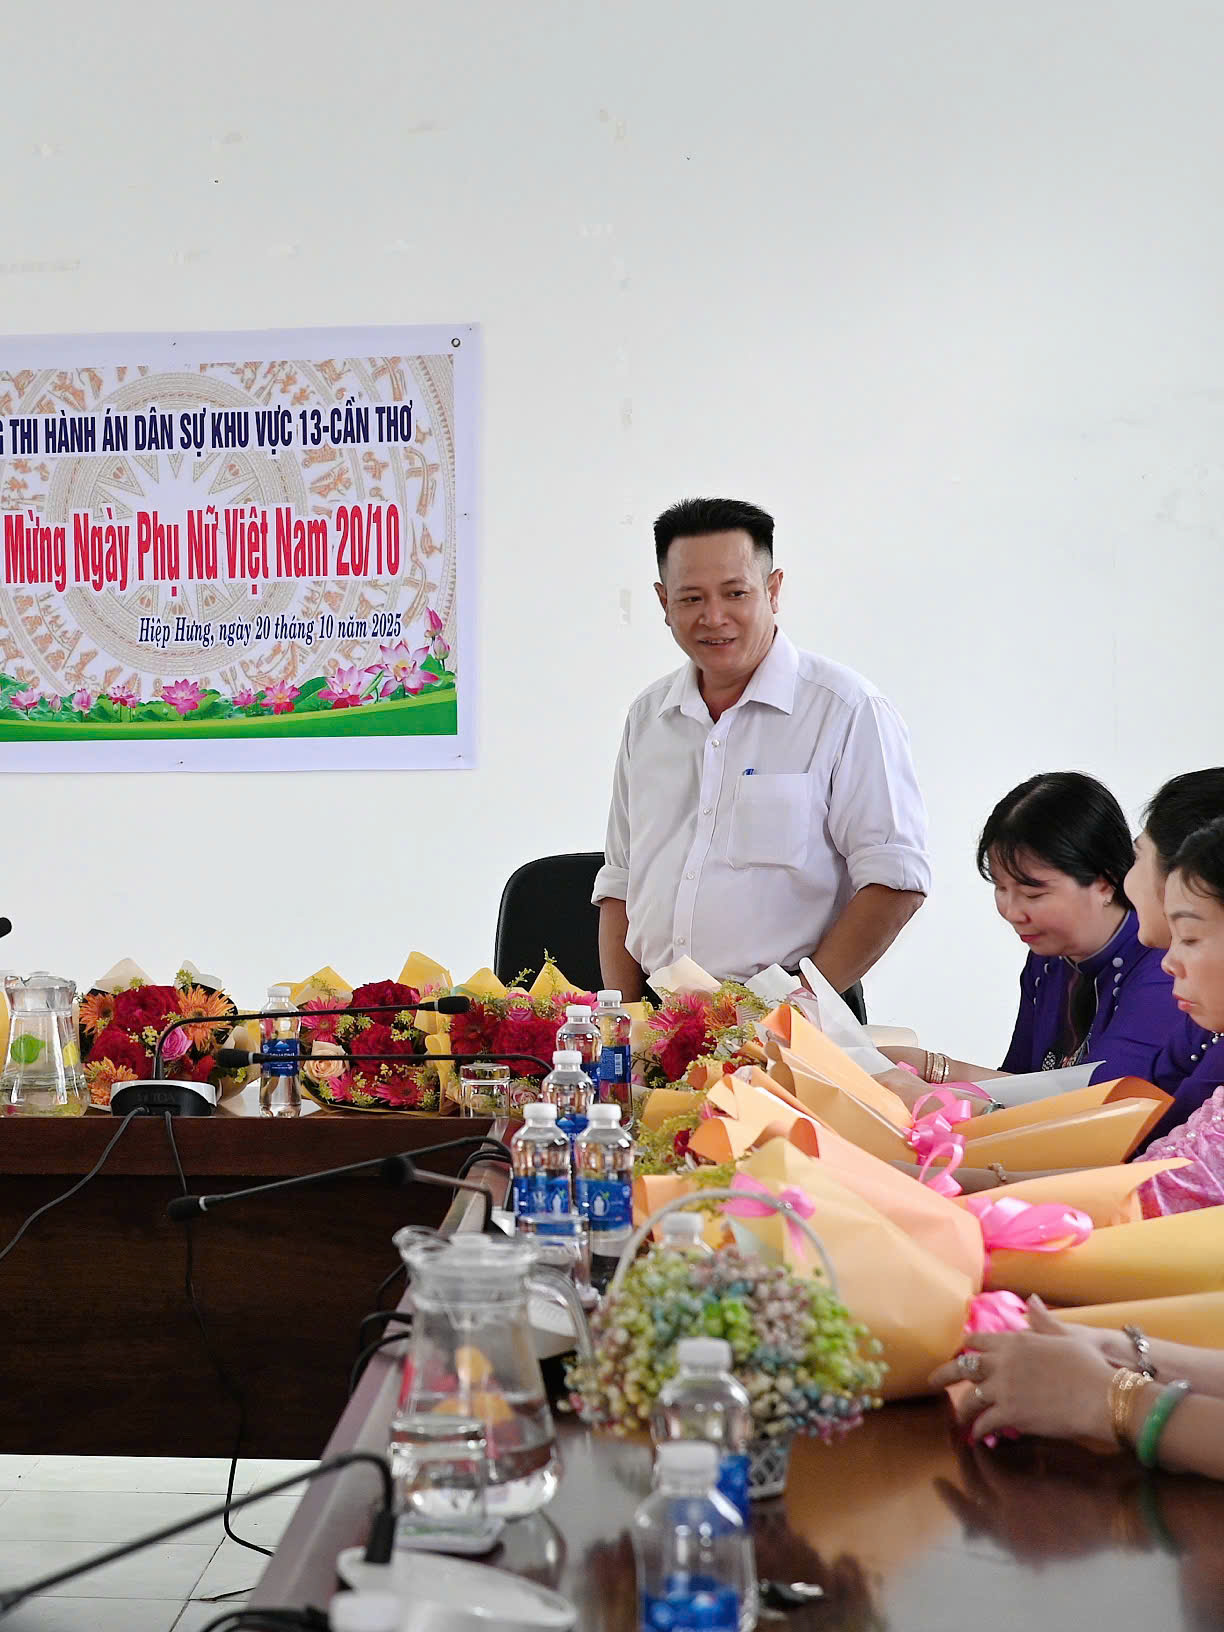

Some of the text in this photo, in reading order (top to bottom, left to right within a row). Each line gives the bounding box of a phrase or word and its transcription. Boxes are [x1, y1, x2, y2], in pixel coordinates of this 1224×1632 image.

[9, 418, 38, 455] THI
[45, 409, 96, 454] HÀNH
[102, 408, 128, 452] ÁN
[134, 406, 174, 451] DÂN
[179, 407, 207, 457] SỰ
[211, 411, 249, 449] KHU
[255, 404, 293, 455] VỰC
[375, 400, 413, 443] THƠ
[4, 509, 67, 592] Mừng
[73, 507, 130, 592] Ngày
[137, 510, 180, 597] Phụ
[187, 505, 219, 580] Nữ
[224, 506, 269, 595] Việt
[275, 507, 328, 578] Nam
[336, 503, 400, 576] 20/10
[139, 613, 402, 648] Hiệp Hưng, ngày 20 tháng 10 năm 2025
